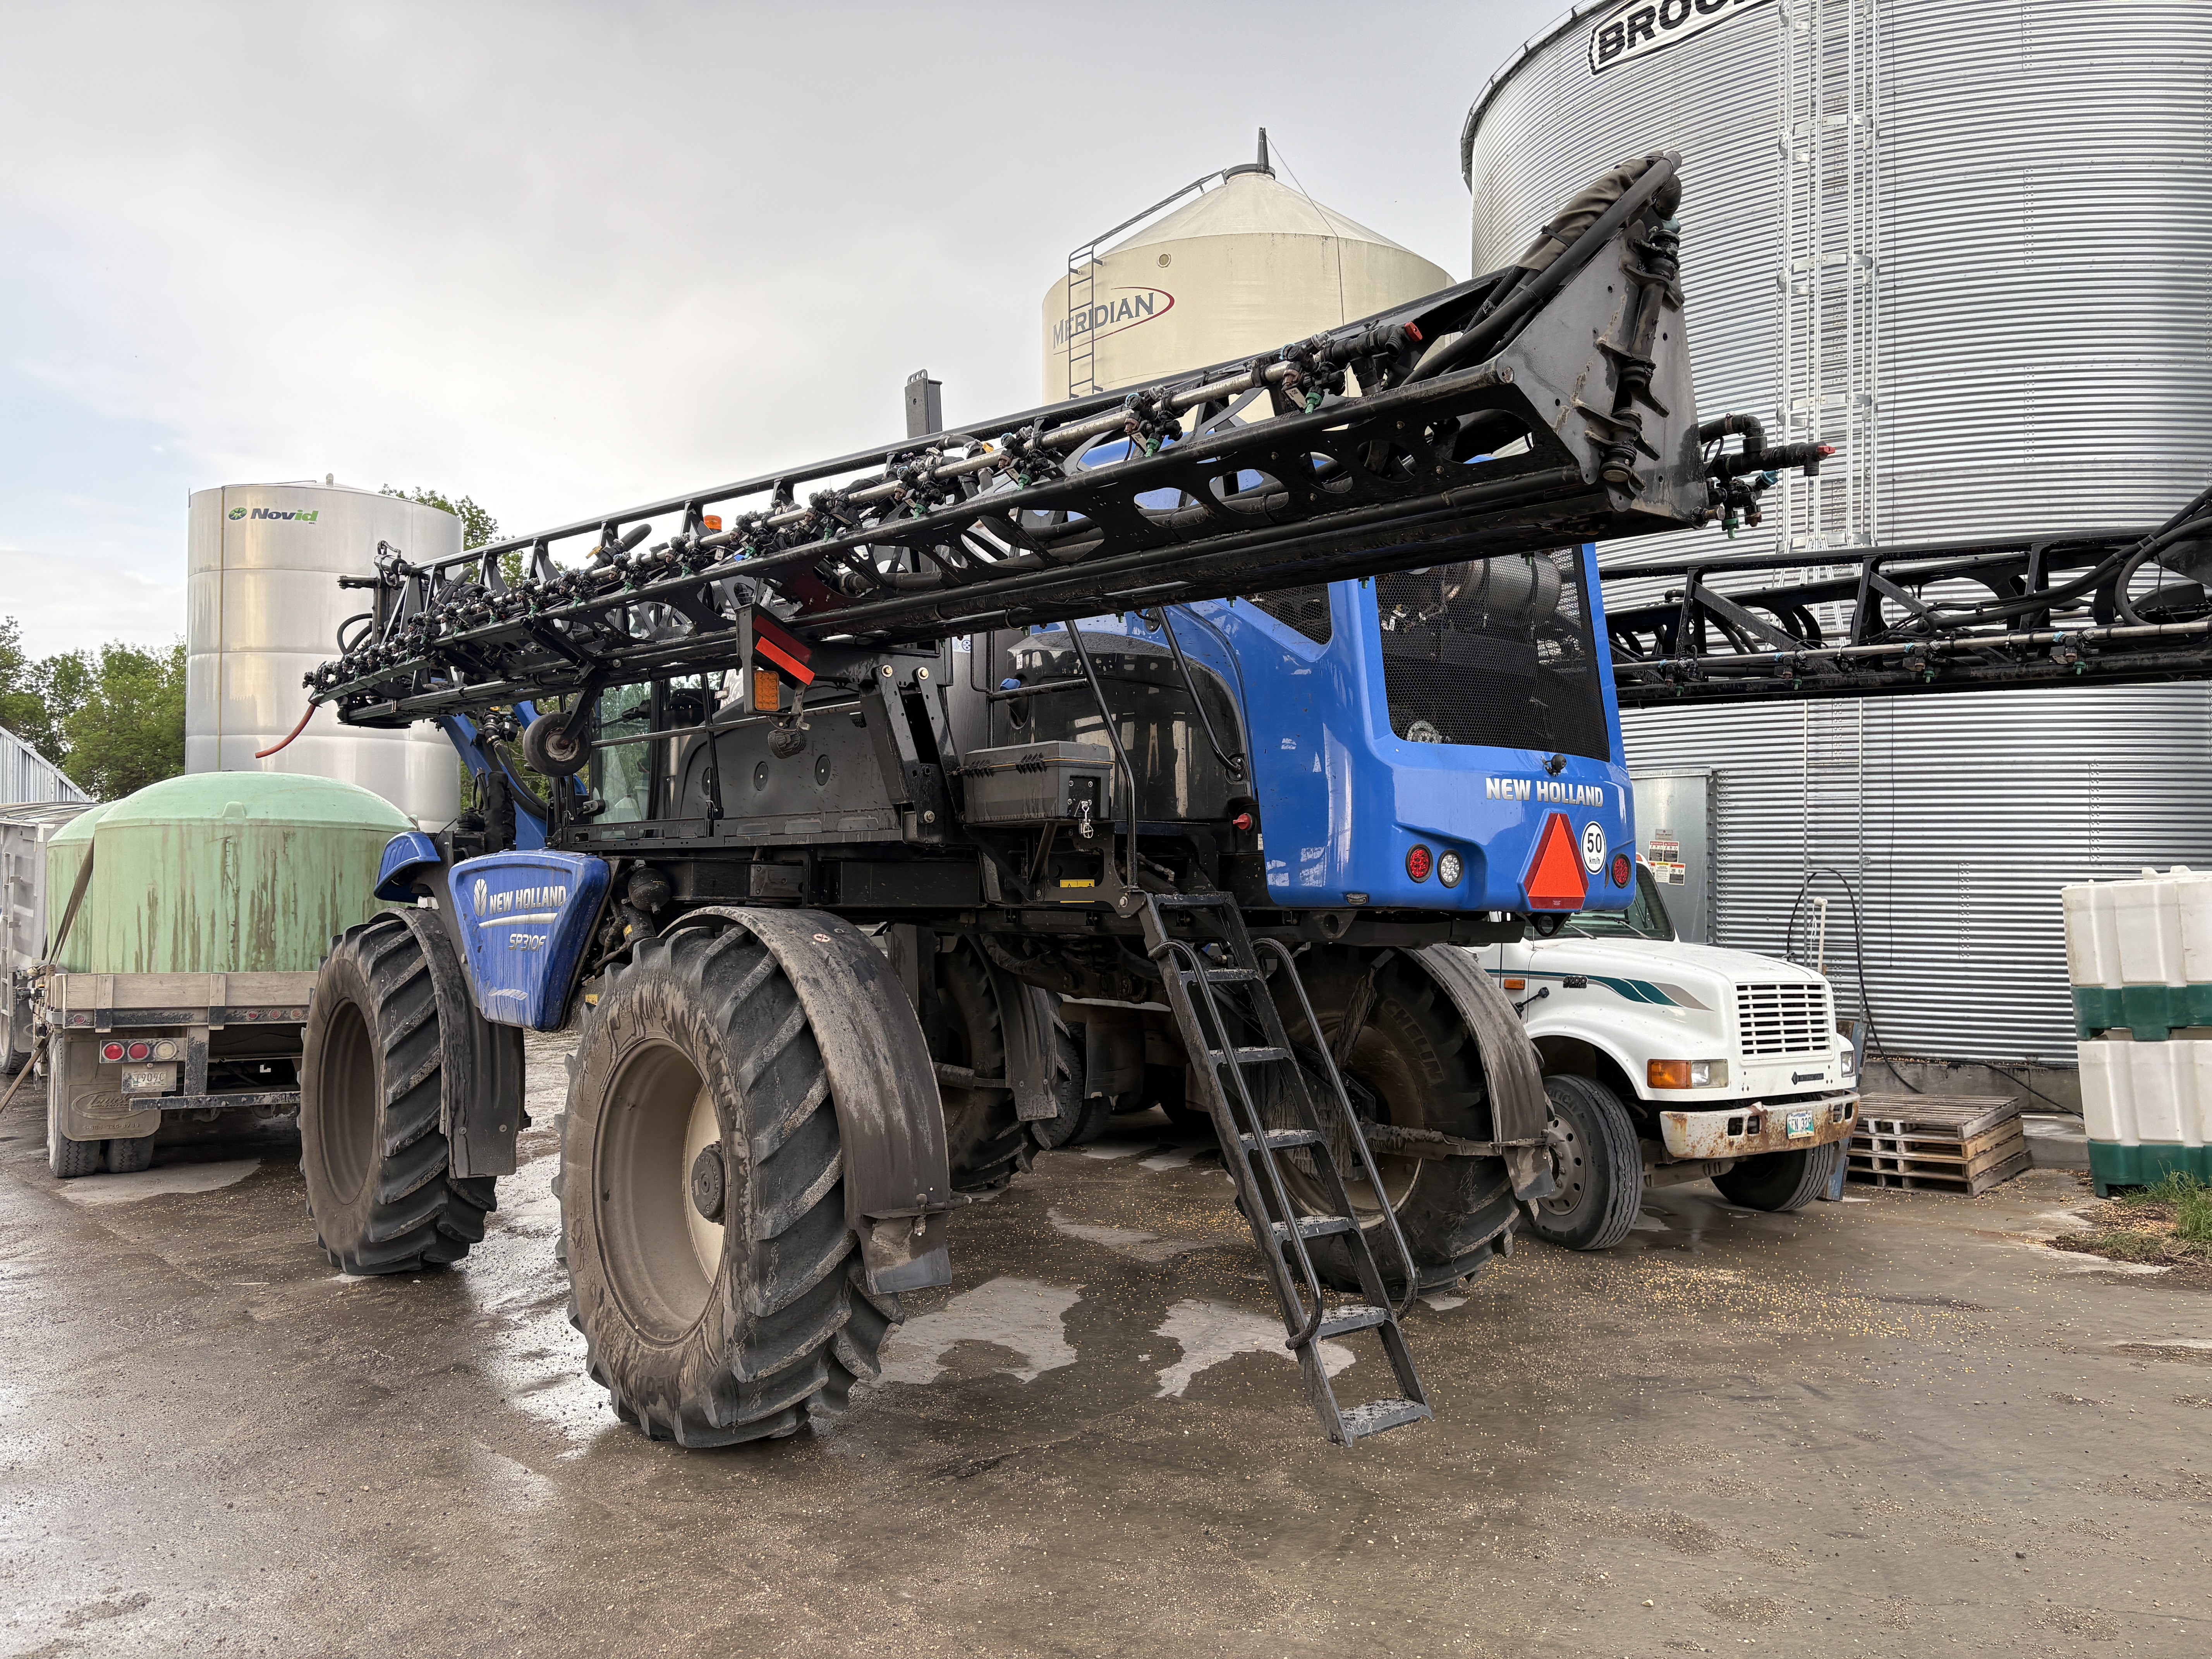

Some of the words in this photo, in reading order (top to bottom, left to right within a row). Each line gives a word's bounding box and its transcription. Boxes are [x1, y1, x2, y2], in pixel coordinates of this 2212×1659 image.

[1598, 0, 1745, 65] BRO
[1053, 292, 1154, 349] MERIDIAN
[251, 508, 319, 521] Novid
[1486, 778, 1531, 801] NEW
[1536, 780, 1603, 807] HOLLAND
[1587, 833, 1602, 853] 50
[1589, 857, 1600, 865] km/h
[489, 891, 513, 915] NEW
[515, 886, 567, 910] HOLLAND
[508, 933, 546, 951] SP310F
[1563, 976, 1587, 984] 4900
